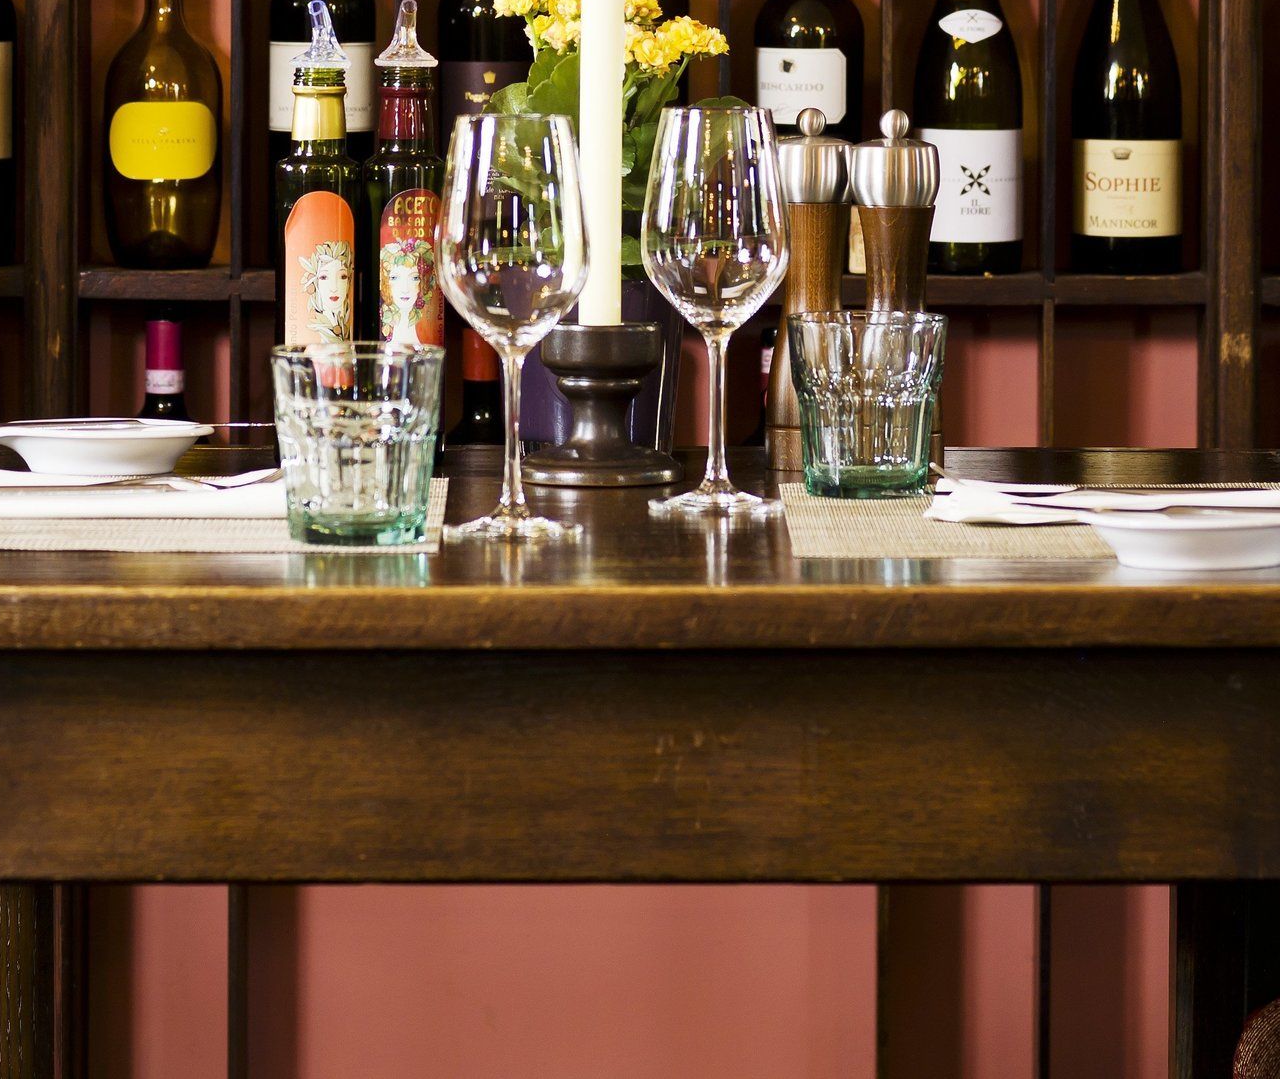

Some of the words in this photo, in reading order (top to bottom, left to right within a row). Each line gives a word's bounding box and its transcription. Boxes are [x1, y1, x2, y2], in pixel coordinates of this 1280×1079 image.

[1085, 172, 1162, 194] SOPHIE
[971, 198, 980, 207] IL
[960, 207, 991, 216] FIORE
[1088, 215, 1159, 230] MANINCOR
